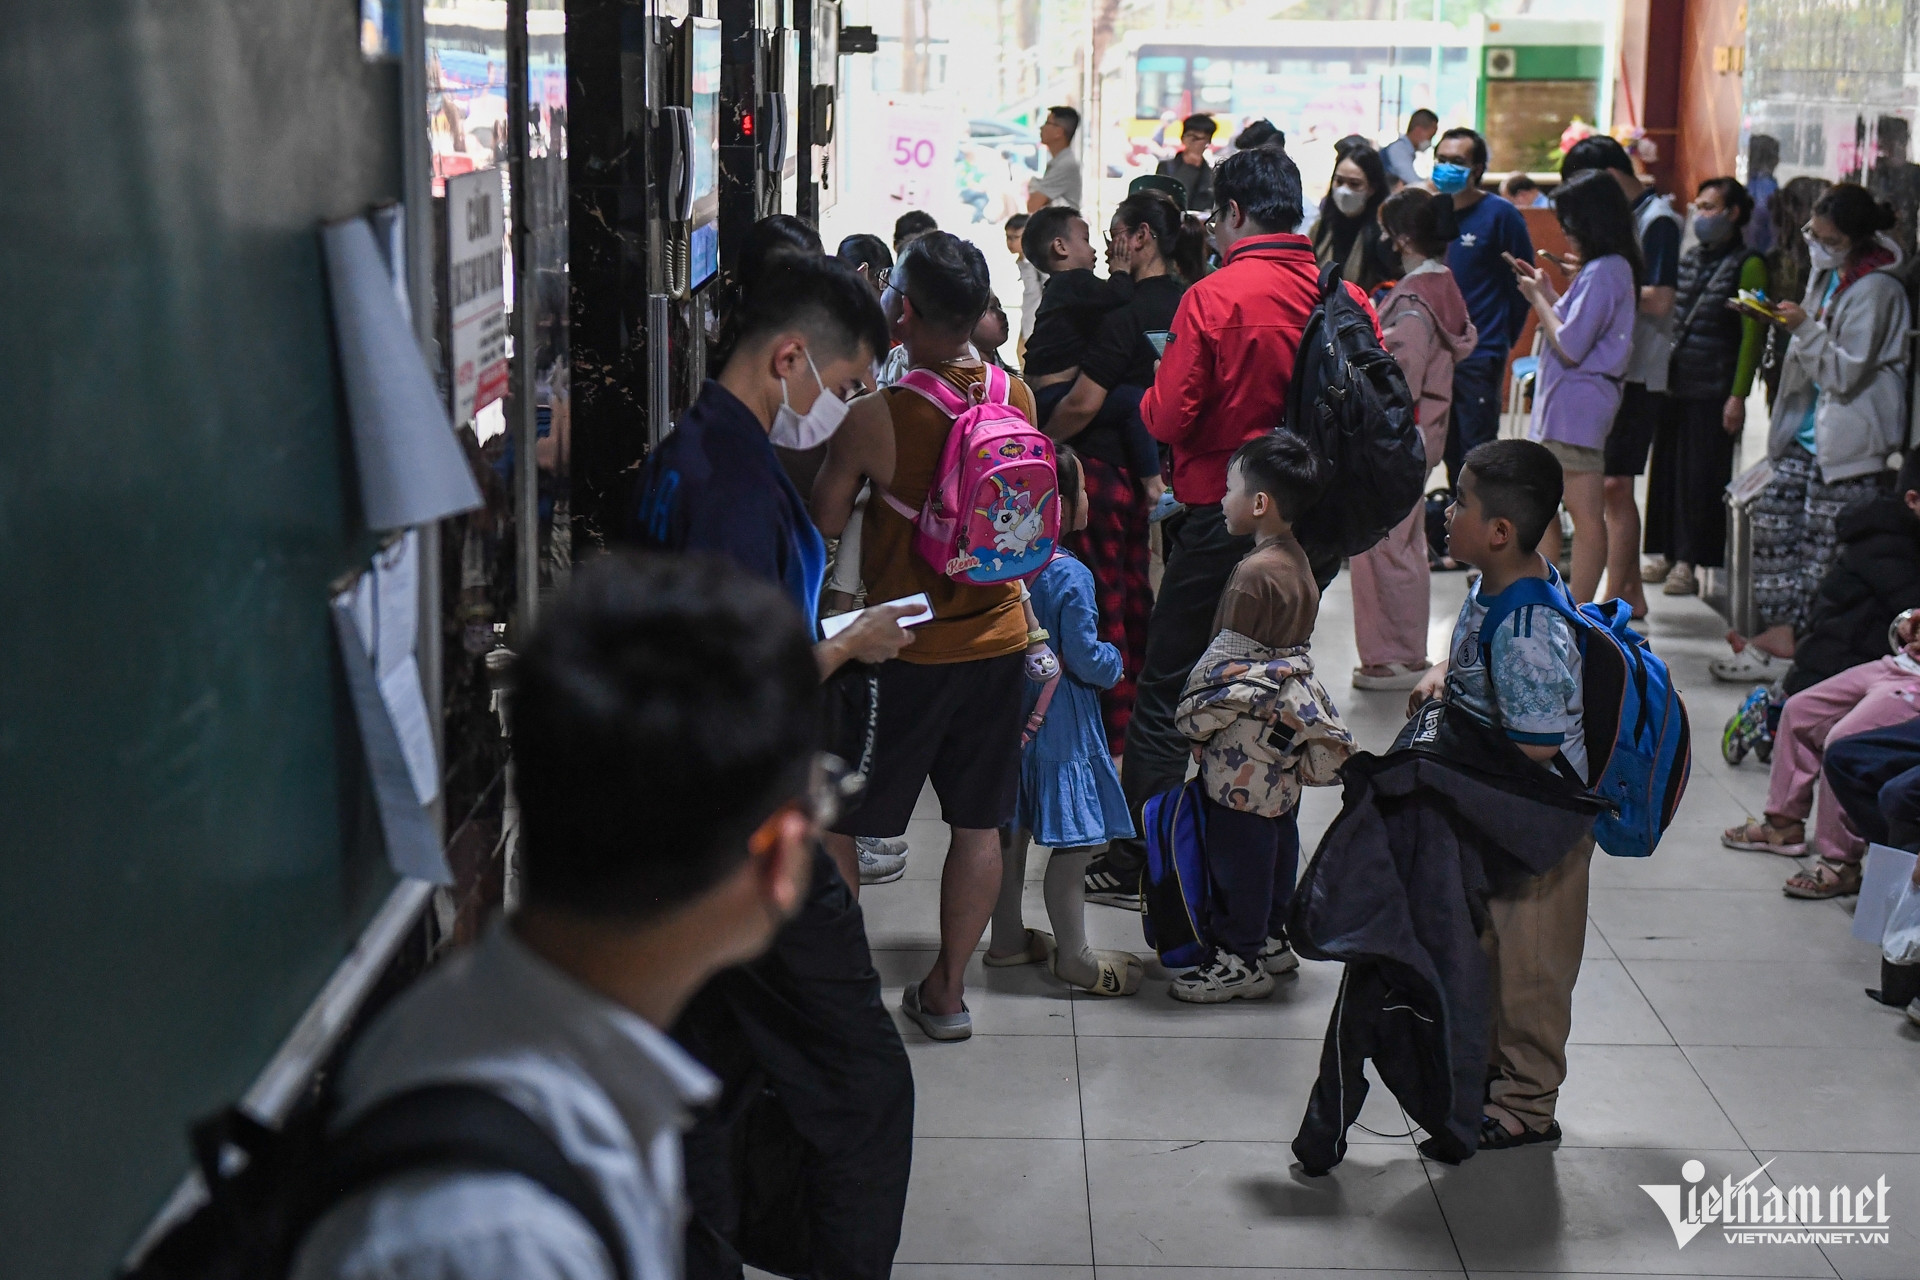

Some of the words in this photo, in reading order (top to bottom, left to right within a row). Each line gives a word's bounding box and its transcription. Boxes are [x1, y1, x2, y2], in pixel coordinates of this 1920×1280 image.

[894, 137, 935, 168] 50
[947, 557, 979, 575] Kem
[868, 678, 878, 726] TEAM
[1102, 968, 1113, 990] NIKE
